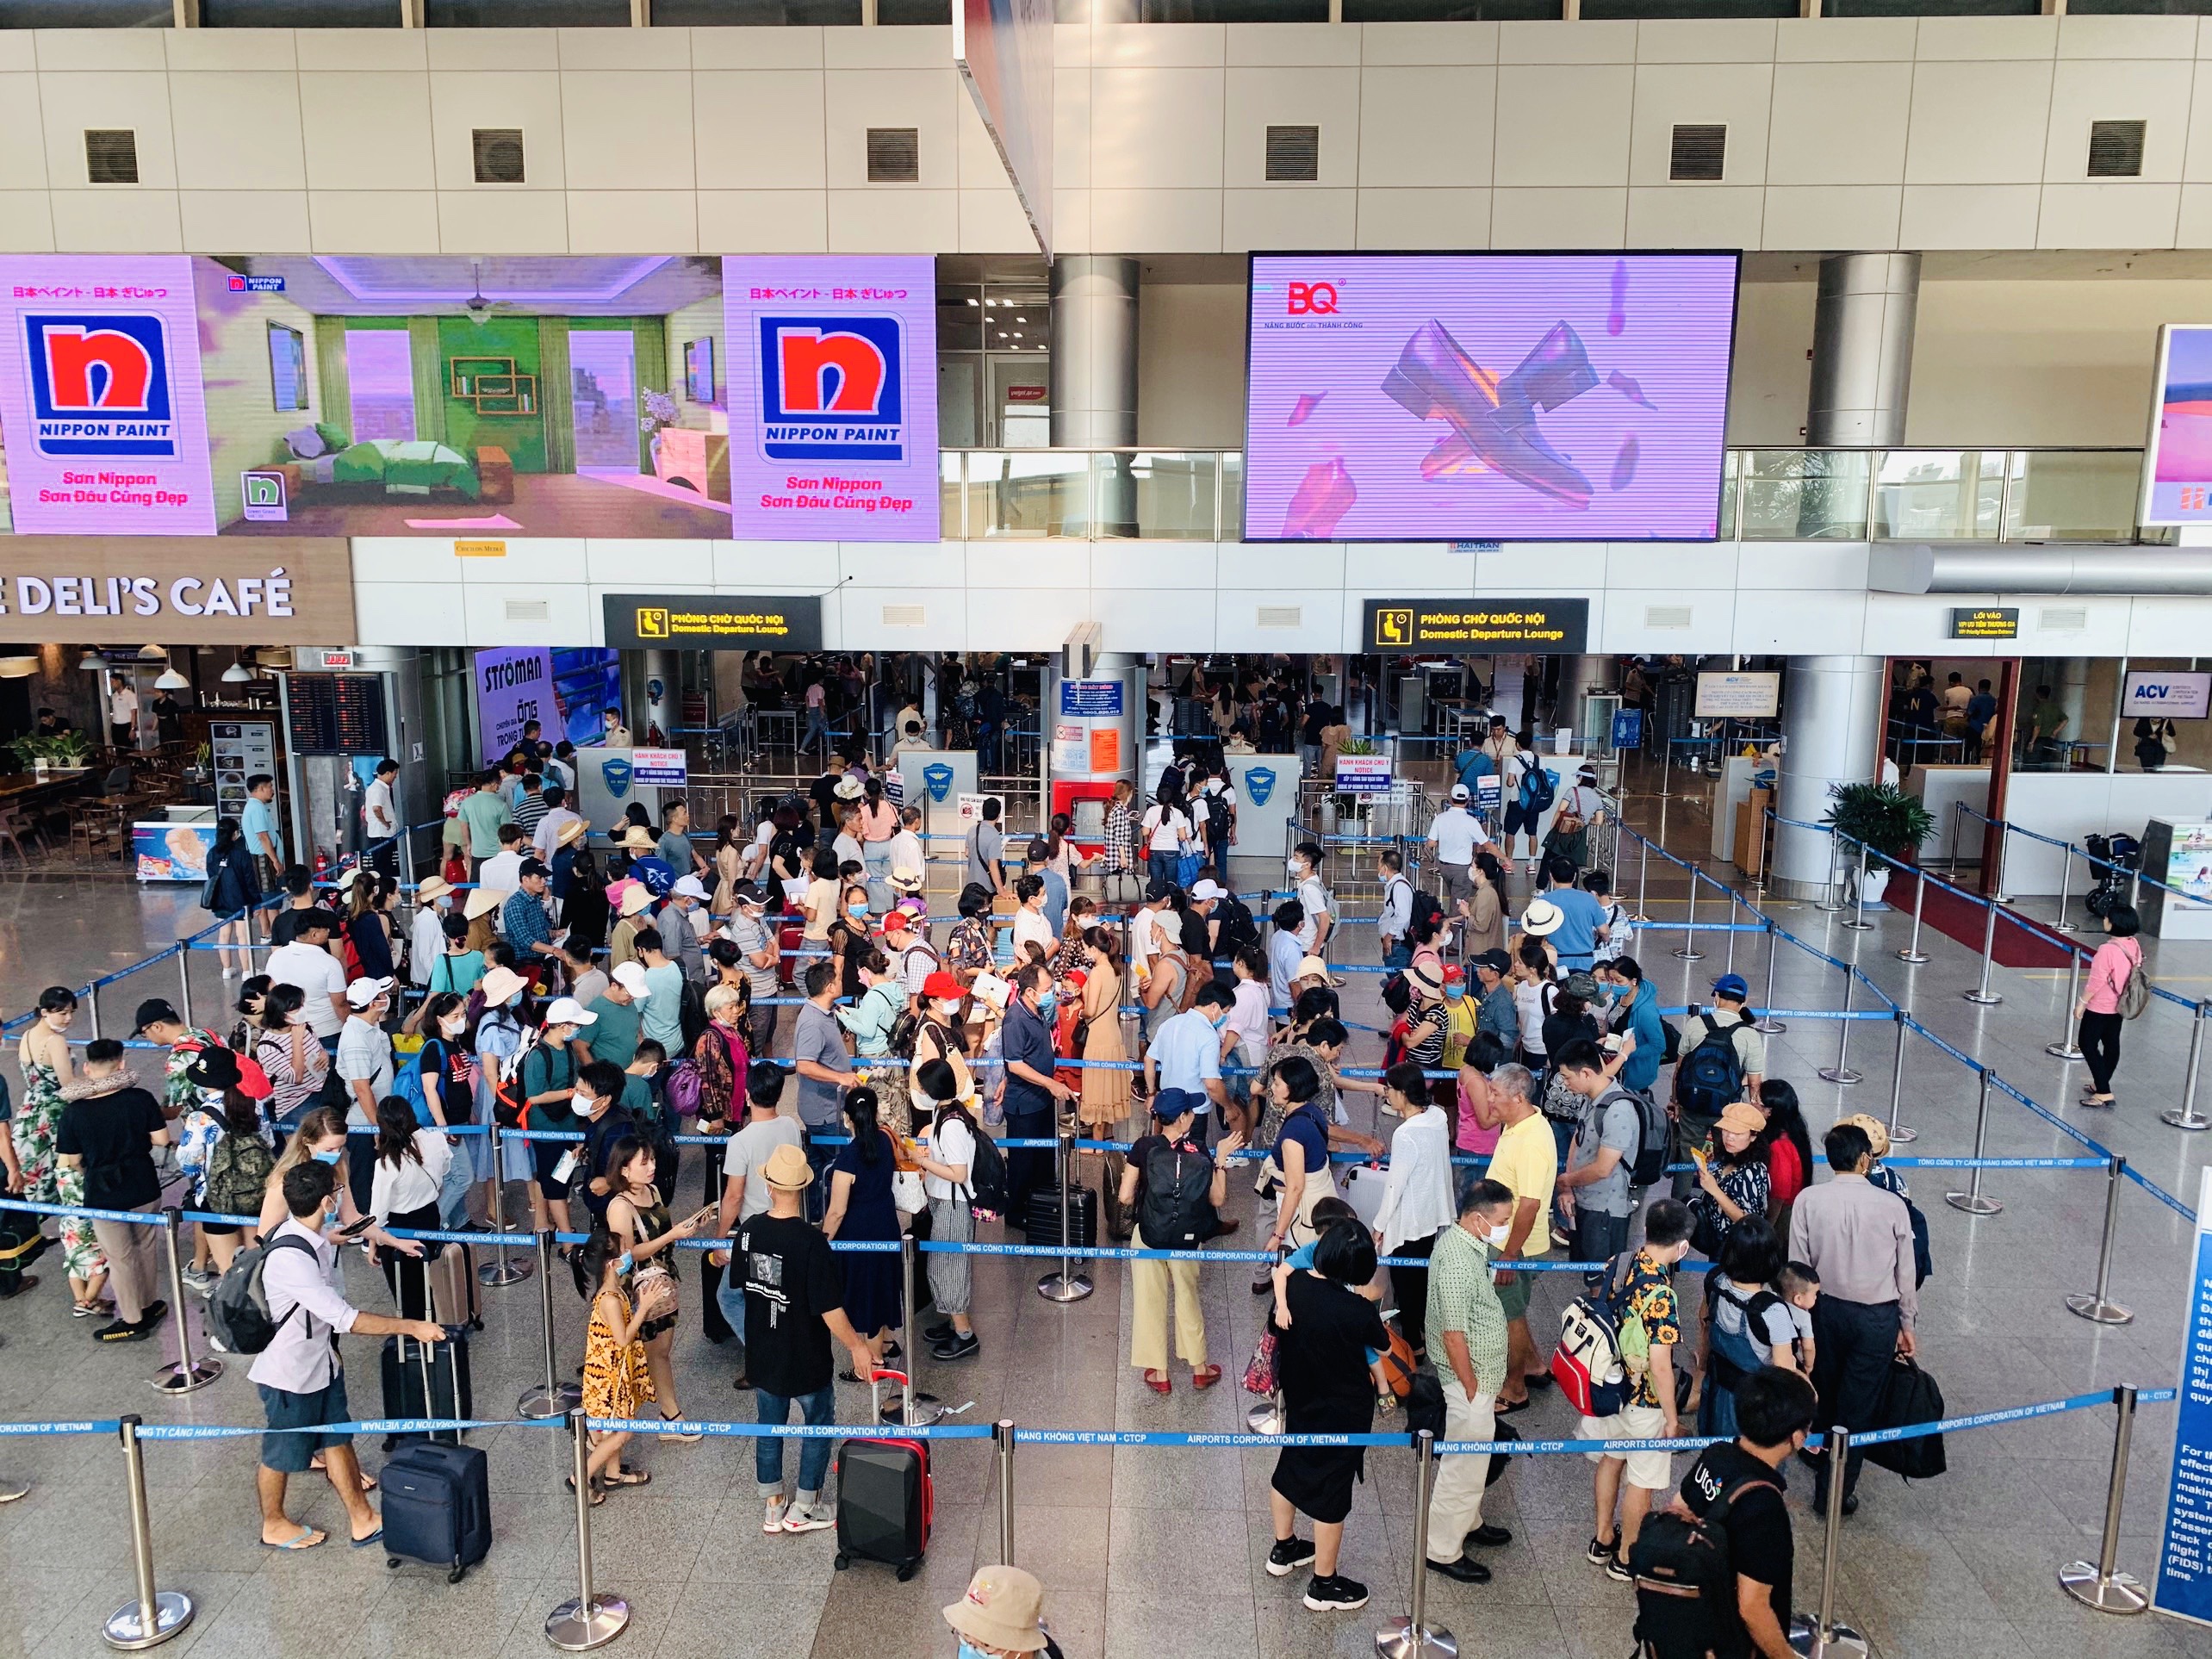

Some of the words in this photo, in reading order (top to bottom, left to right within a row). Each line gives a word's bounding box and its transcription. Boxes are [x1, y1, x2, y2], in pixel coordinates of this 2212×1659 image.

[1288, 282, 1340, 315] BQ
[40, 423, 109, 437] NIPPON
[116, 424, 171, 437] PAINT
[766, 427, 838, 440] NIPPON
[844, 428, 900, 441] PAINT
[98, 471, 157, 488] Nippon
[822, 476, 882, 493] Nippon
[16, 576, 161, 616] DELI'S
[170, 566, 295, 617] CAFÉ
[672, 612, 708, 624] PHÒNG
[709, 613, 732, 624] CHỜ
[766, 614, 784, 626] NỘI
[1420, 612, 1460, 624] PHÒNG
[1463, 612, 1488, 624] CHỜ
[1492, 612, 1523, 624] QUỐC
[1525, 613, 1544, 626] NỘI
[672, 624, 712, 633] Domestic
[713, 624, 755, 635] Departure
[756, 625, 788, 636] Lounge
[1420, 630, 1468, 639] Domestic
[1470, 630, 1522, 640] Departure
[1525, 630, 1563, 641] Lounge
[2134, 684, 2170, 699] ACV
[108, 1211, 122, 1220] NAM
[127, 1213, 143, 1221] CTCP
[413, 1231, 445, 1240] AIRPORTS
[447, 1233, 491, 1242] CORPORATION
[504, 1235, 531, 1244] VIETNAM
[983, 1244, 1003, 1252] CÔNG
[1057, 1246, 1082, 1255] KHÔNG
[1084, 1247, 1099, 1257] VIỆT
[1206, 1252, 1256, 1260] CORPORATION
[2153, 1391, 2172, 1400] CTCP
[1937, 1418, 1973, 1431] AIRPORTS
[1973, 1407, 2023, 1424] CORPORATION
[2025, 1407, 2035, 1416] OF
[2035, 1401, 2066, 1414] VIETNAM
[40, 1423, 50, 1432] OF
[53, 1422, 92, 1432] VIETNAM
[156, 1426, 168, 1437] TY
[361, 1420, 400, 1431] VIETNAM
[604, 1418, 627, 1429] HÀNG
[630, 1419, 660, 1430] KHÔNG
[662, 1421, 680, 1432] VIỆT
[683, 1422, 701, 1432] NAM
[708, 1424, 731, 1432] CTCP
[771, 1426, 814, 1435] AIRPORTS
[816, 1426, 877, 1436] CORPORATION
[879, 1427, 890, 1436] OF
[892, 1427, 929, 1437] VIETNAM
[1017, 1430, 1042, 1441] HÀNG
[1044, 1431, 1074, 1442] KHÔNG
[1077, 1432, 1095, 1444] VIỆT
[1097, 1433, 1116, 1443] NAM
[1123, 1434, 1146, 1443] CTCP
[1187, 1435, 1230, 1444] AIRPORTS
[1233, 1435, 1295, 1445] CORPORATION
[1296, 1436, 1308, 1445] OF
[1310, 1436, 1348, 1445] VIETNAM
[1861, 1432, 1877, 1443] NAM
[1882, 1430, 1902, 1440] CTCP
[1461, 1441, 1492, 1451] KHÔNG
[1494, 1443, 1513, 1453] VIỆT
[1515, 1443, 1533, 1451] NAM
[1541, 1442, 1564, 1451] CTCP
[1603, 1439, 1646, 1450] AIRPORTS
[1648, 1438, 1709, 1449] CORPORATION
[2182, 1445, 2203, 1457] For
[2176, 1494, 2195, 1506] the
[2172, 1531, 2200, 1545] track
[2170, 1542, 2199, 1558] flight
[2168, 1554, 2203, 1574] (FIDS)
[2166, 1567, 2194, 1582] time.
